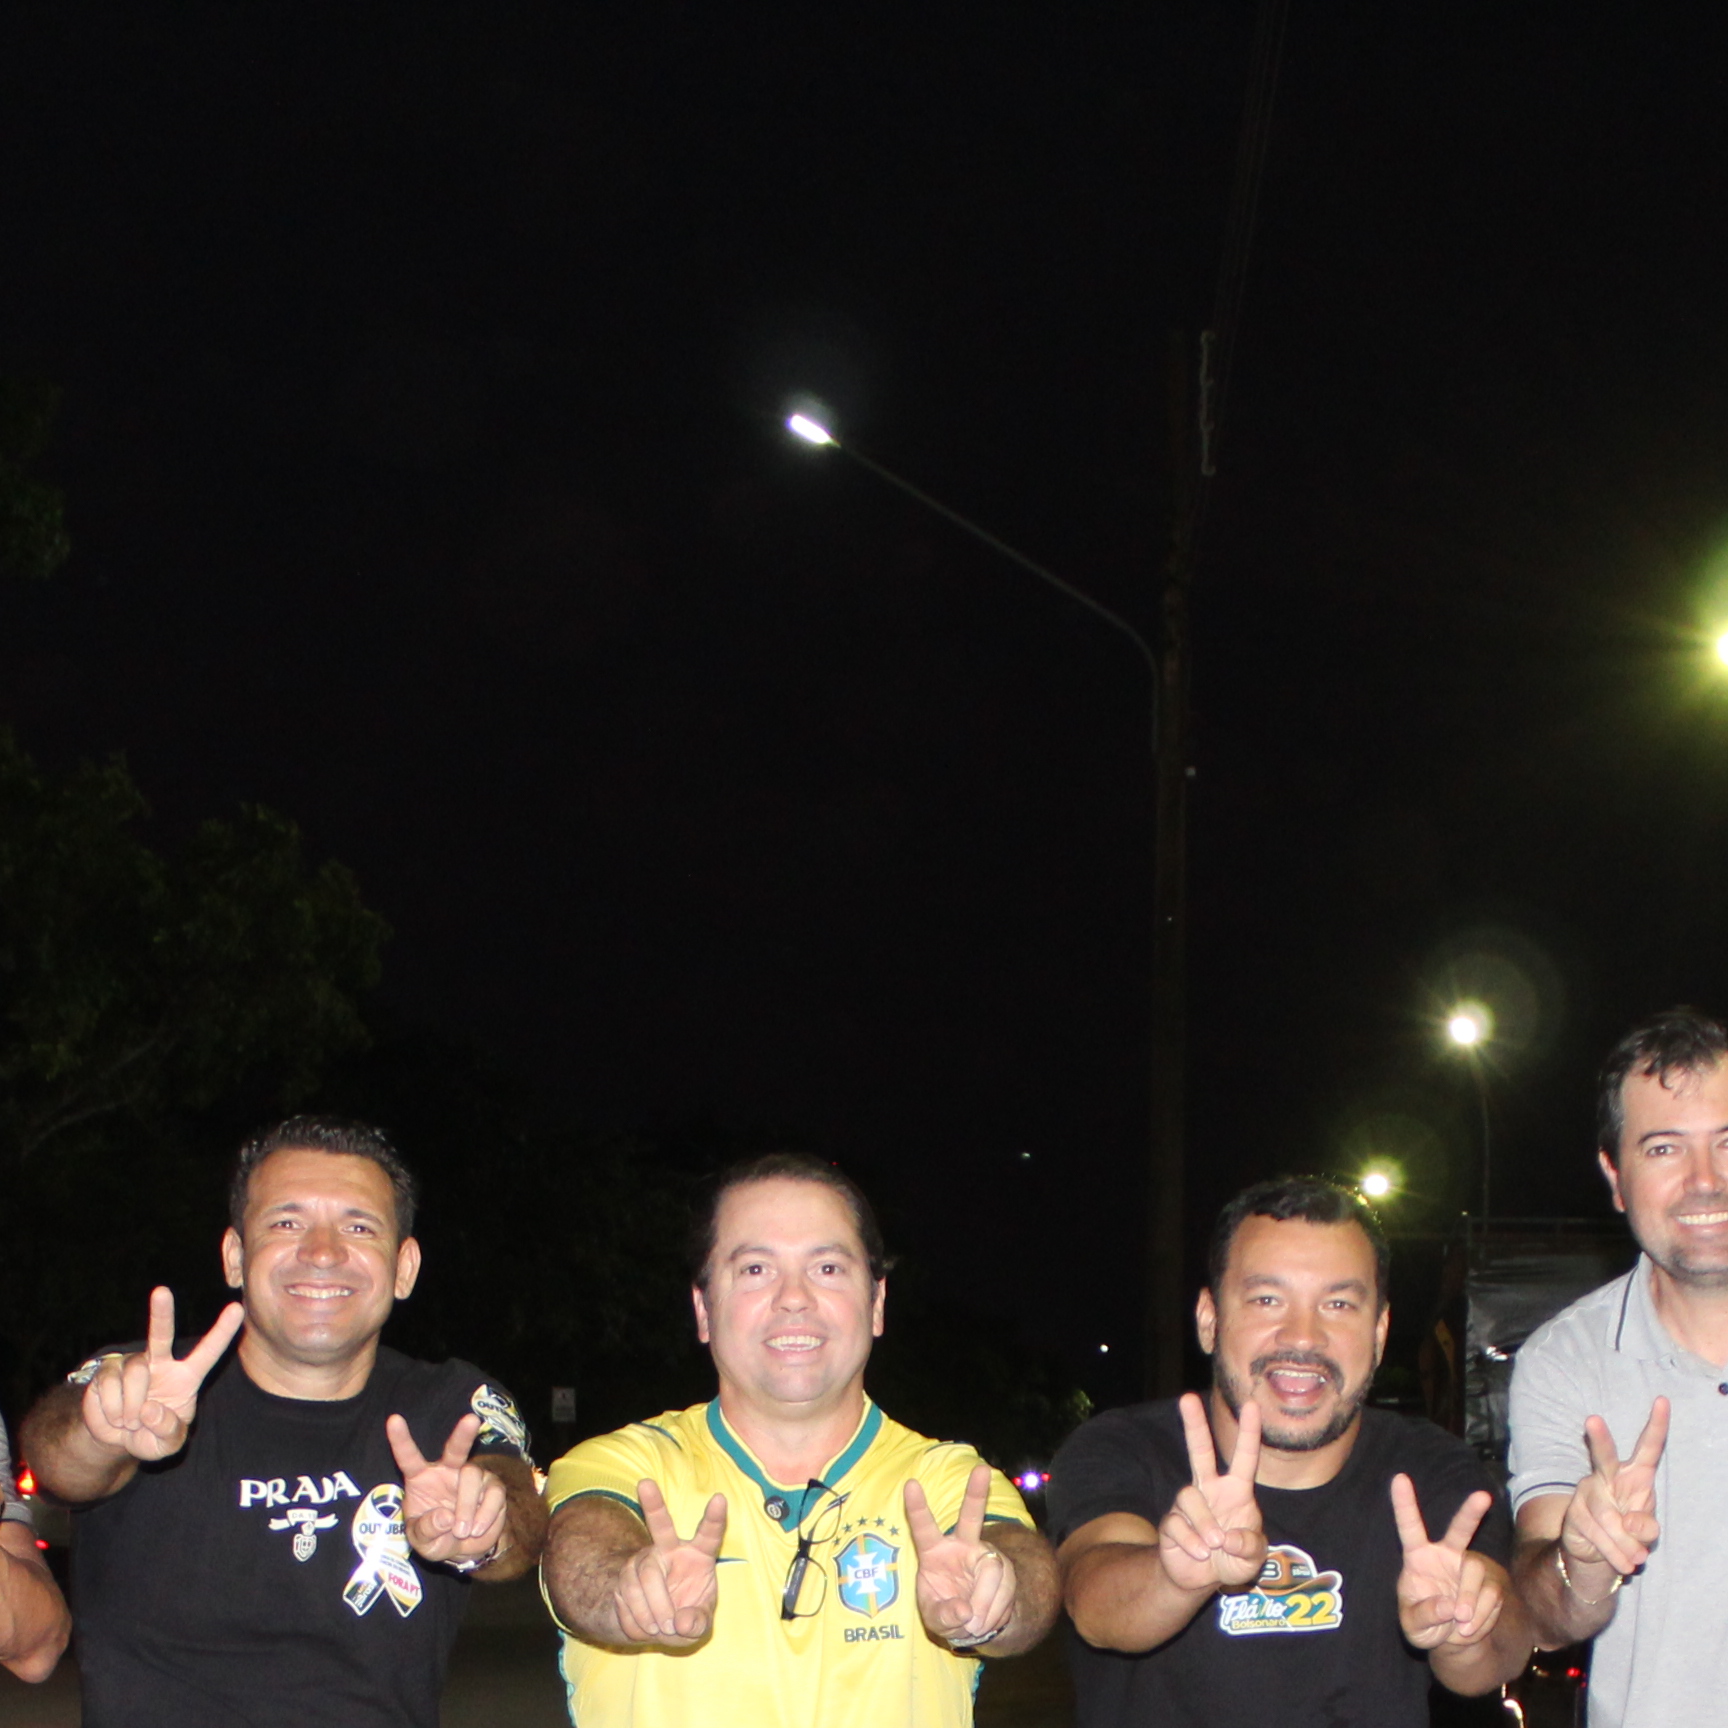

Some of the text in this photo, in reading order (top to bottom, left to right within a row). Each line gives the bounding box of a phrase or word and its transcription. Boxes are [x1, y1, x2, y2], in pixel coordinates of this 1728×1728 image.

[359, 1523, 406, 1535] OUTUBR
[854, 1567, 879, 1579] CBF
[388, 1572, 409, 1592] FORA
[1286, 1592, 1337, 1625] 22
[1233, 1619, 1285, 1630] Bolsonaro
[844, 1624, 905, 1643] BRASIL
